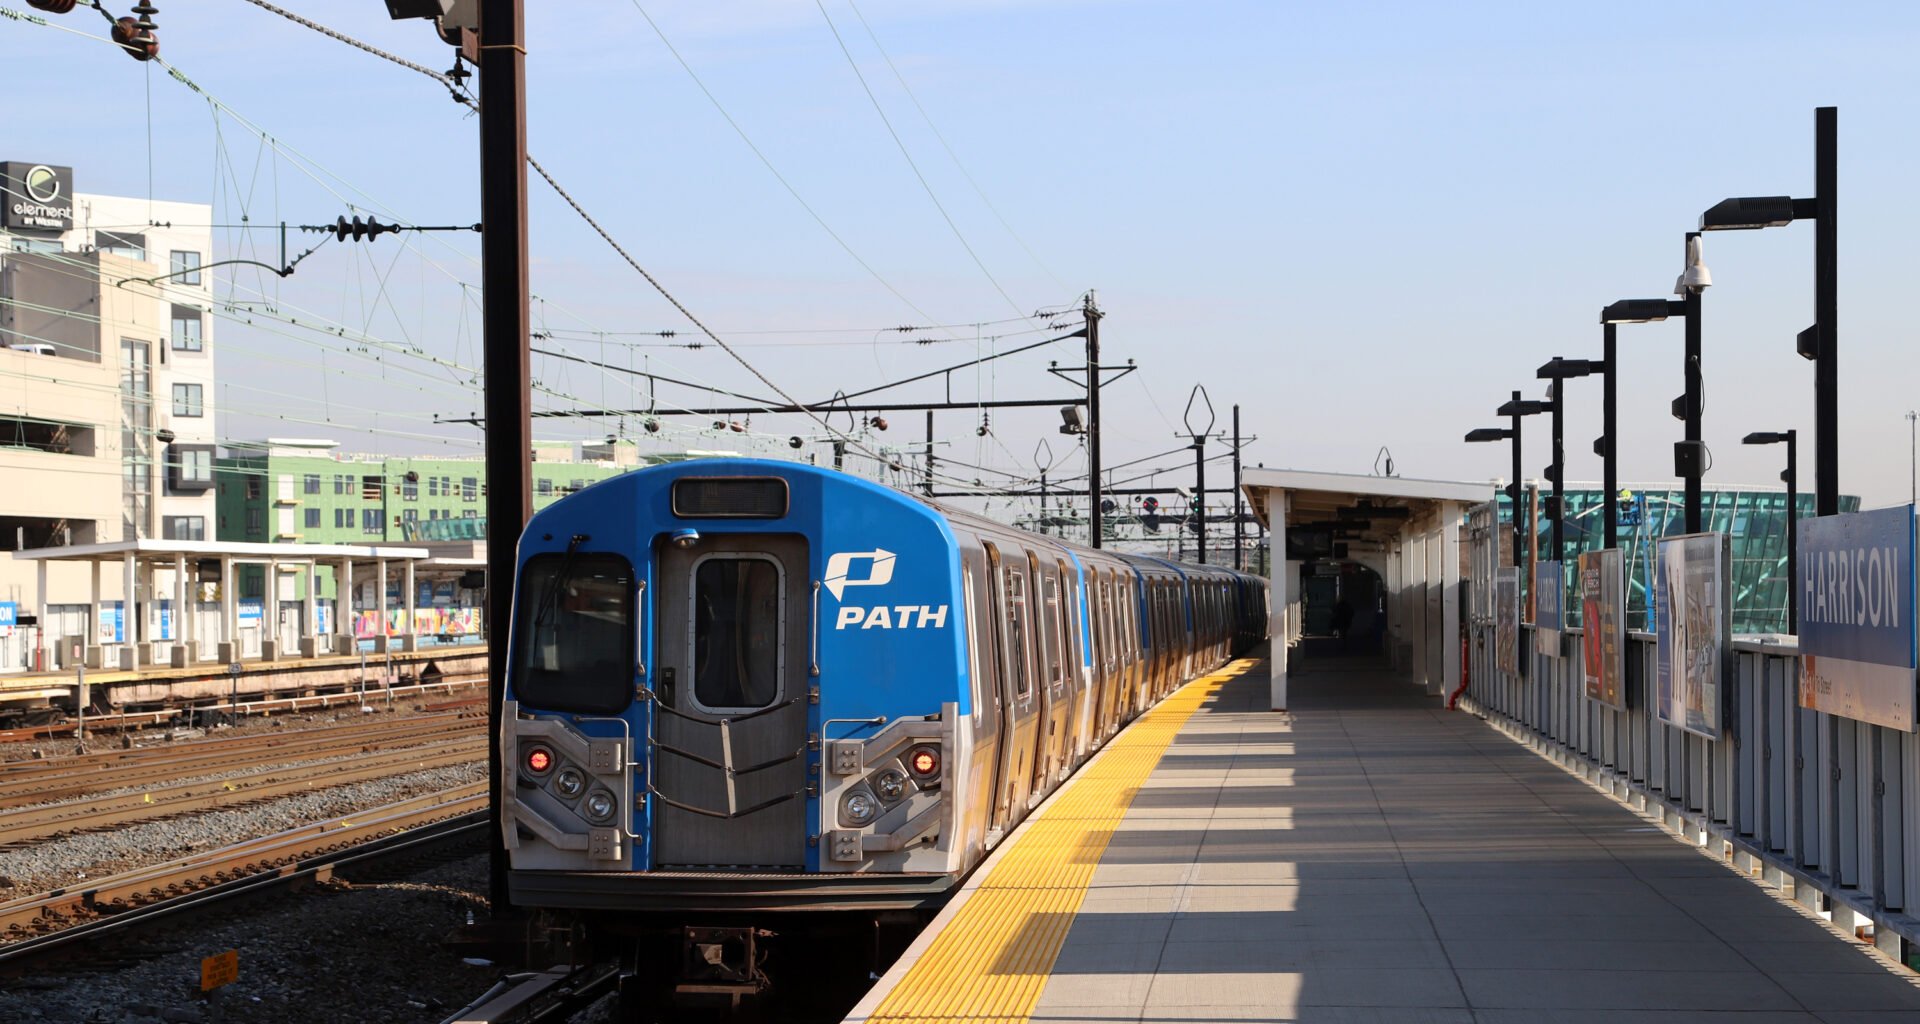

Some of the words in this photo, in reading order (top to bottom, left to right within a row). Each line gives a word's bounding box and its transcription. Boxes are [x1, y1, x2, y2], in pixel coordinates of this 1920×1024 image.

[13, 202, 72, 218] element
[24, 217, 34, 225] BY
[1805, 547, 1899, 628] HARRISON
[835, 604, 948, 630] PATH
[230, 664, 240, 672] 25
